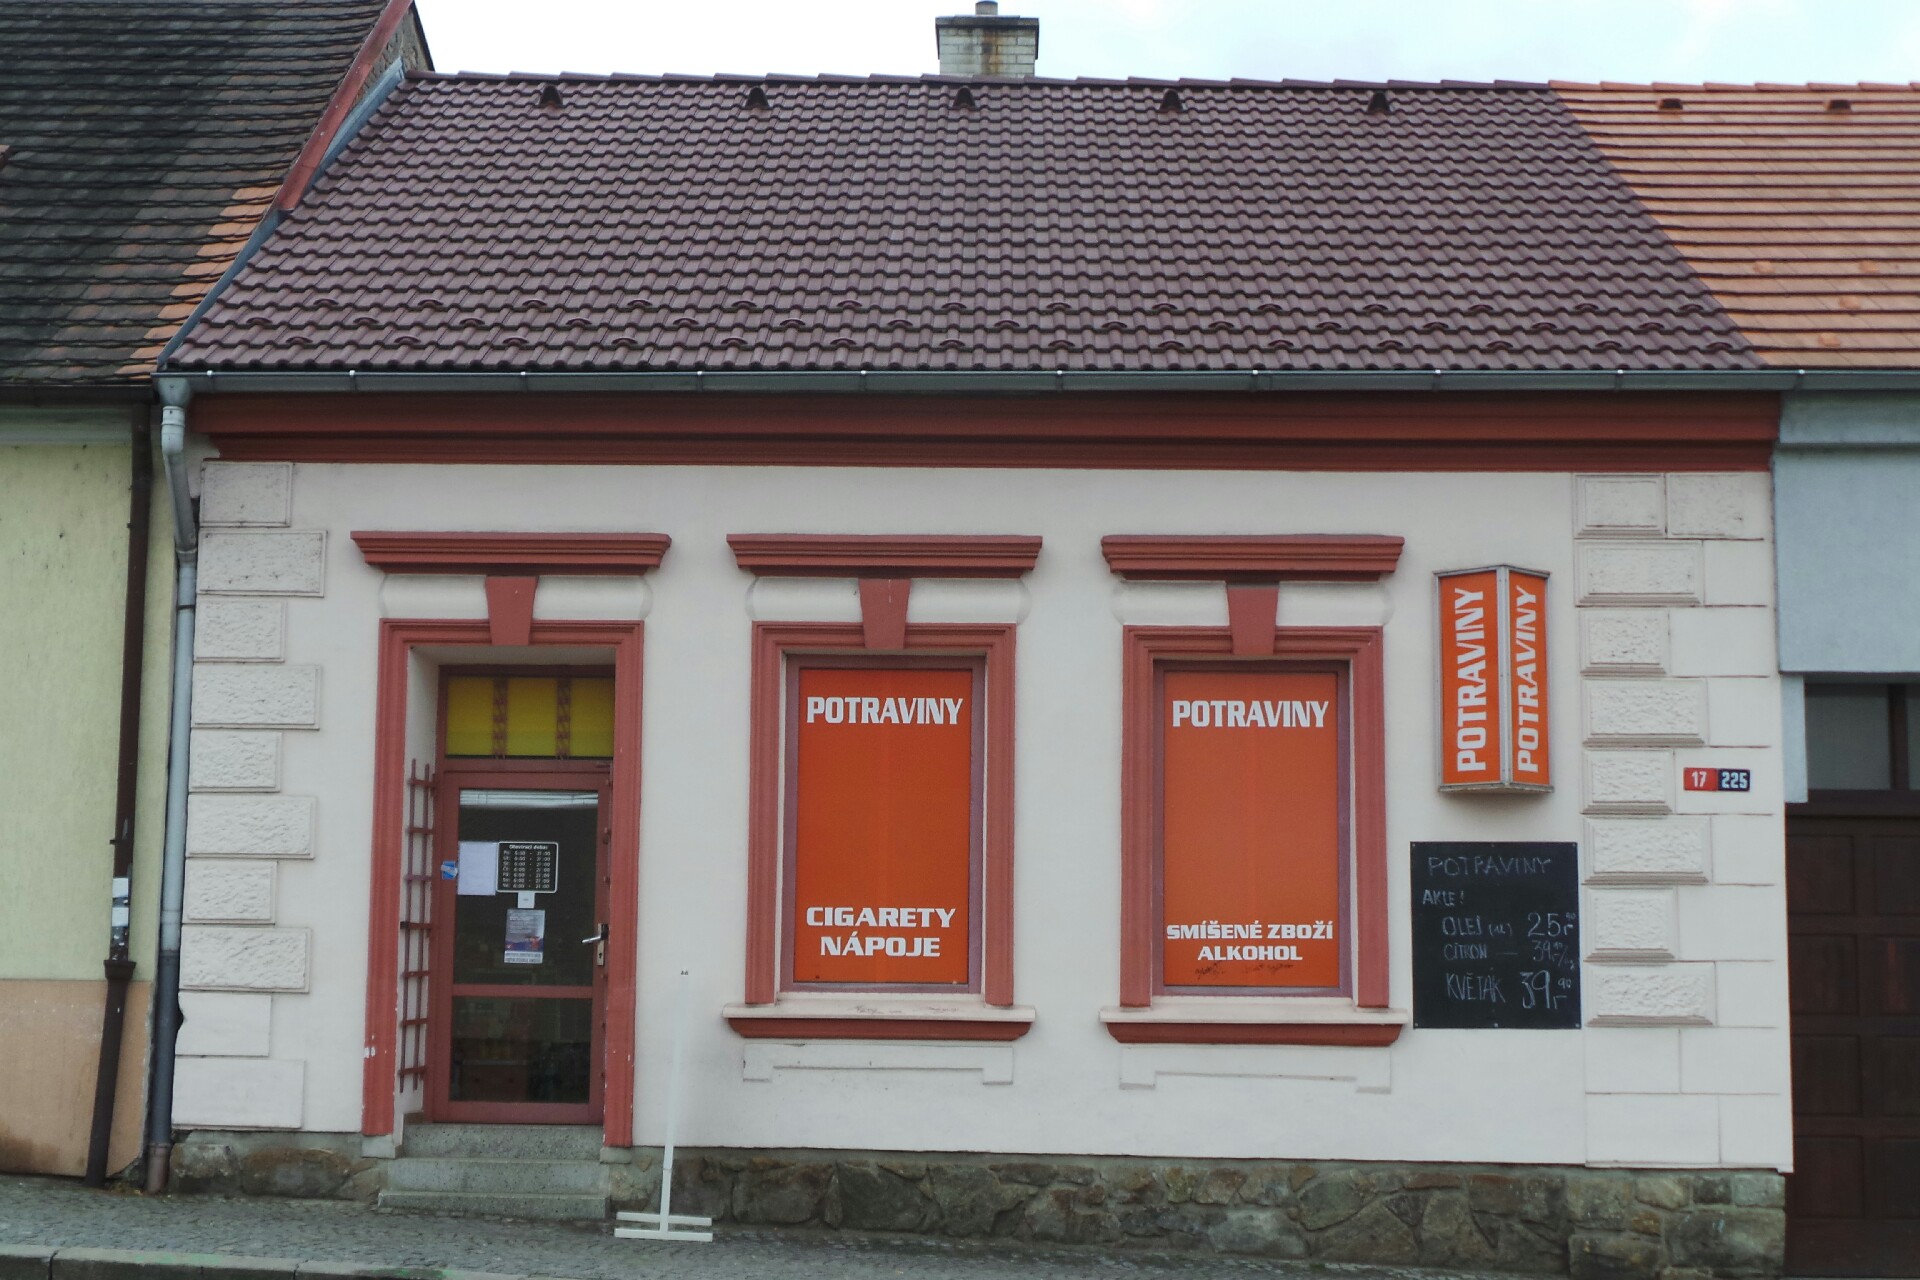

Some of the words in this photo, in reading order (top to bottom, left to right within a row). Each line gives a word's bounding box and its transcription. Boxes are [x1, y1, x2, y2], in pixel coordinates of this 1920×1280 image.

[1454, 587, 1487, 772] POTRAVINY
[1515, 585, 1539, 773] POTRAVINY
[806, 696, 964, 725] POTRAVINY
[1172, 700, 1329, 728] POTRAVINY
[1691, 770, 1708, 788] 17
[1721, 771, 1748, 789] 225
[1428, 856, 1552, 876] POTRAVINY
[806, 906, 956, 928] CIGARETY
[1441, 915, 1483, 936] OLEJ
[1166, 919, 1262, 940] SMÍŠENÉ
[1267, 919, 1334, 940] ZBOŽÍ
[820, 931, 941, 957] NÁPOJE
[1197, 945, 1303, 961] ALKOHOL
